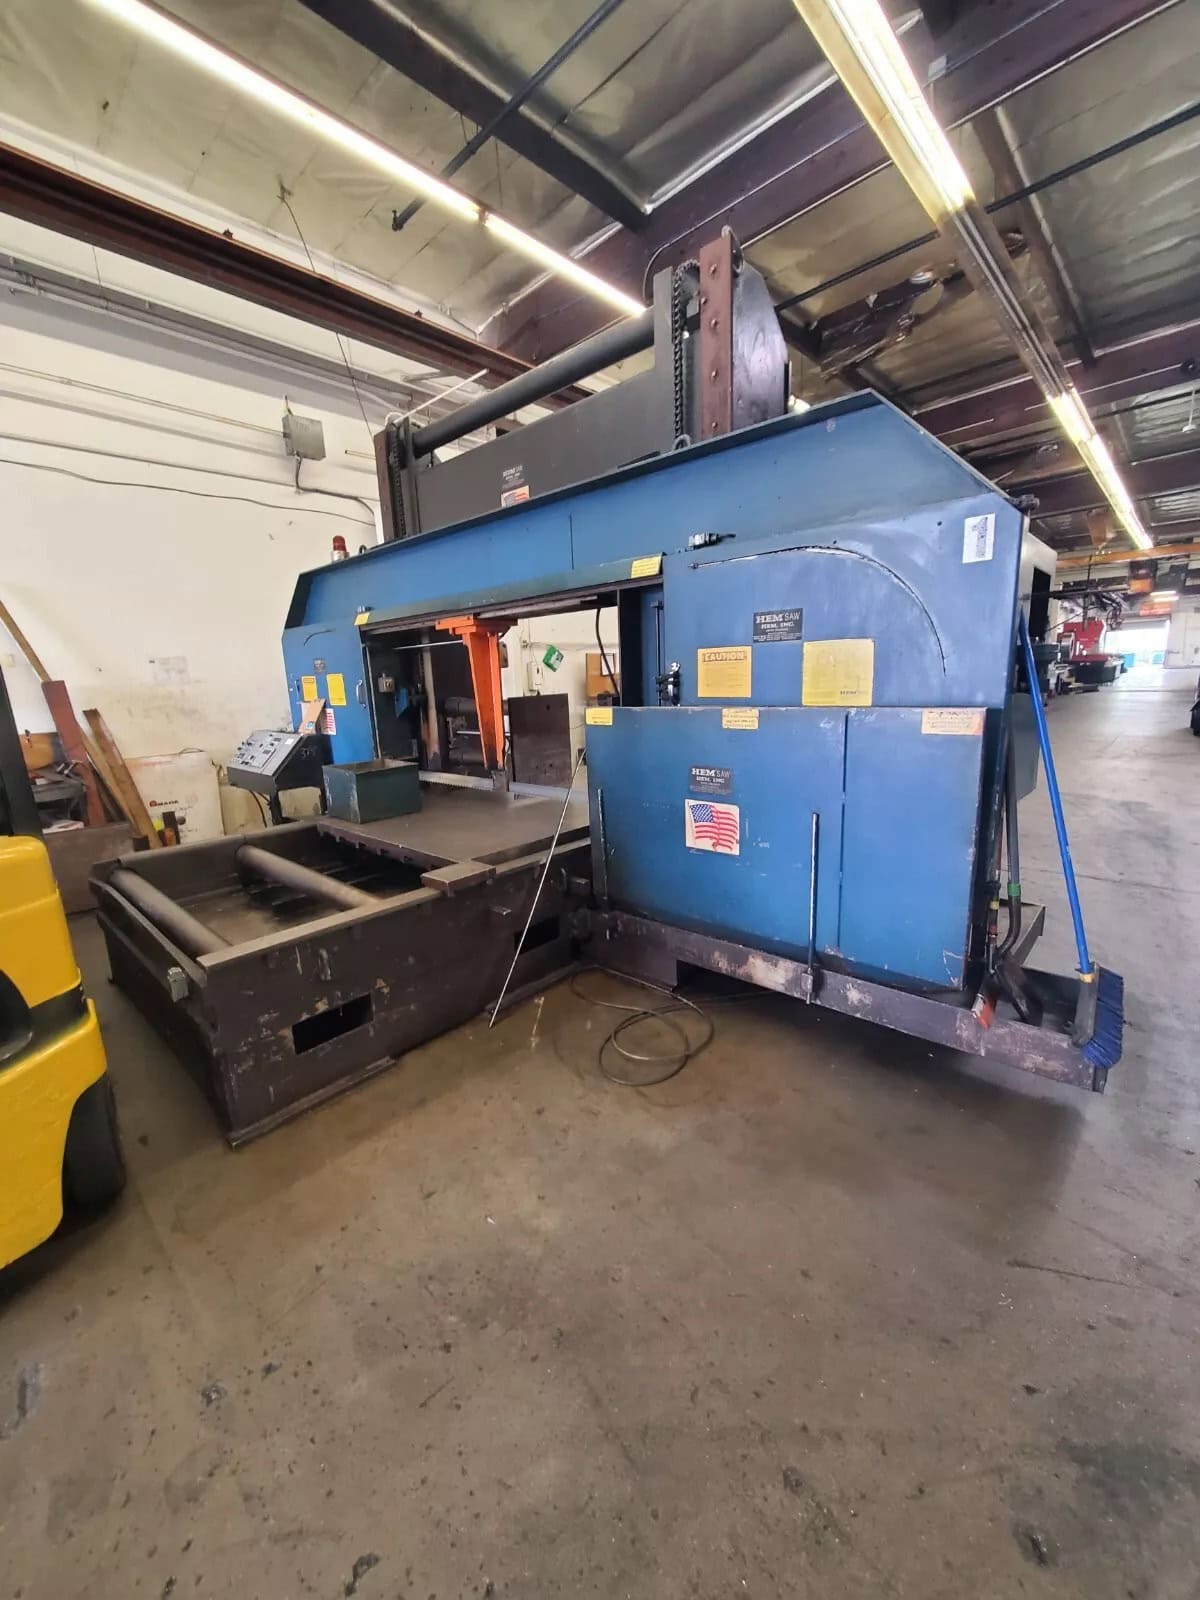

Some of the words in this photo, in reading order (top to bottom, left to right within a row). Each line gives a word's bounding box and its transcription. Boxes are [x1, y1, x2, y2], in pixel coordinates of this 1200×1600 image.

[755, 614, 785, 624] HEM
[784, 612, 801, 621] SAW
[704, 652, 745, 662] CAUTION
[691, 767, 715, 777] HEM
